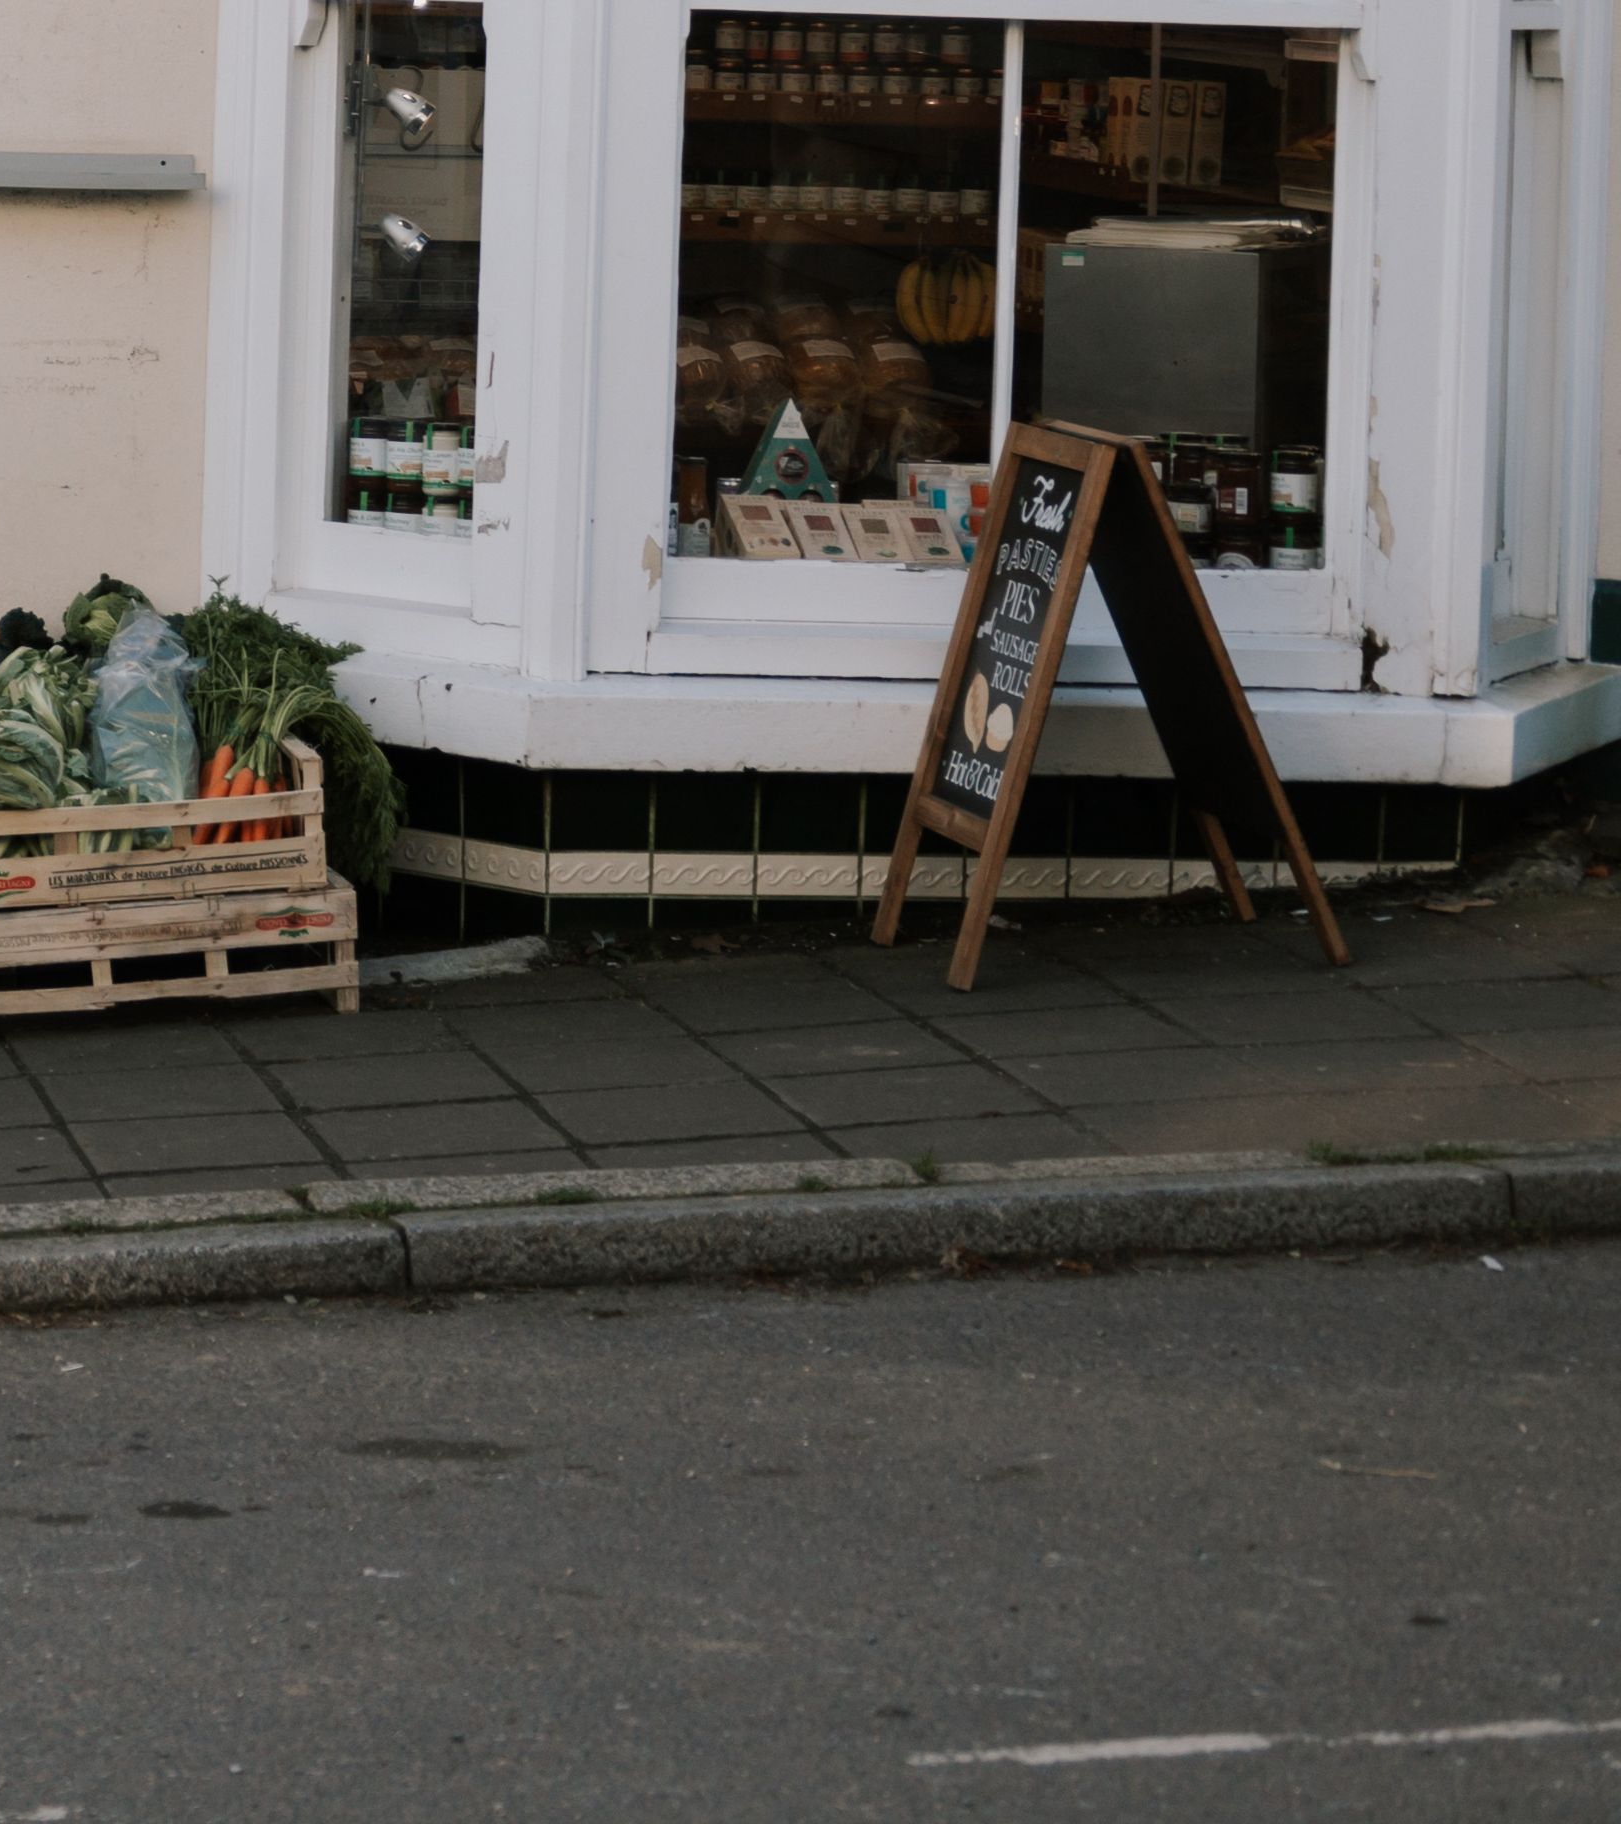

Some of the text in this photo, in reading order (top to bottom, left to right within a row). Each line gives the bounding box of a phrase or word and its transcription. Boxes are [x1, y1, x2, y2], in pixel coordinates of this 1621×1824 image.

[1021, 475, 1073, 534] Fresh
[996, 537, 1063, 592] PASTIES
[1000, 579, 1040, 625] PIES
[990, 627, 1040, 666] SAUSAGE
[991, 661, 1032, 700] ROLLS
[48, 874, 63, 888] LES
[120, 870, 134, 881] de
[136, 867, 168, 880] Nature
[211, 862, 223, 873] de
[224, 860, 257, 872] Culture
